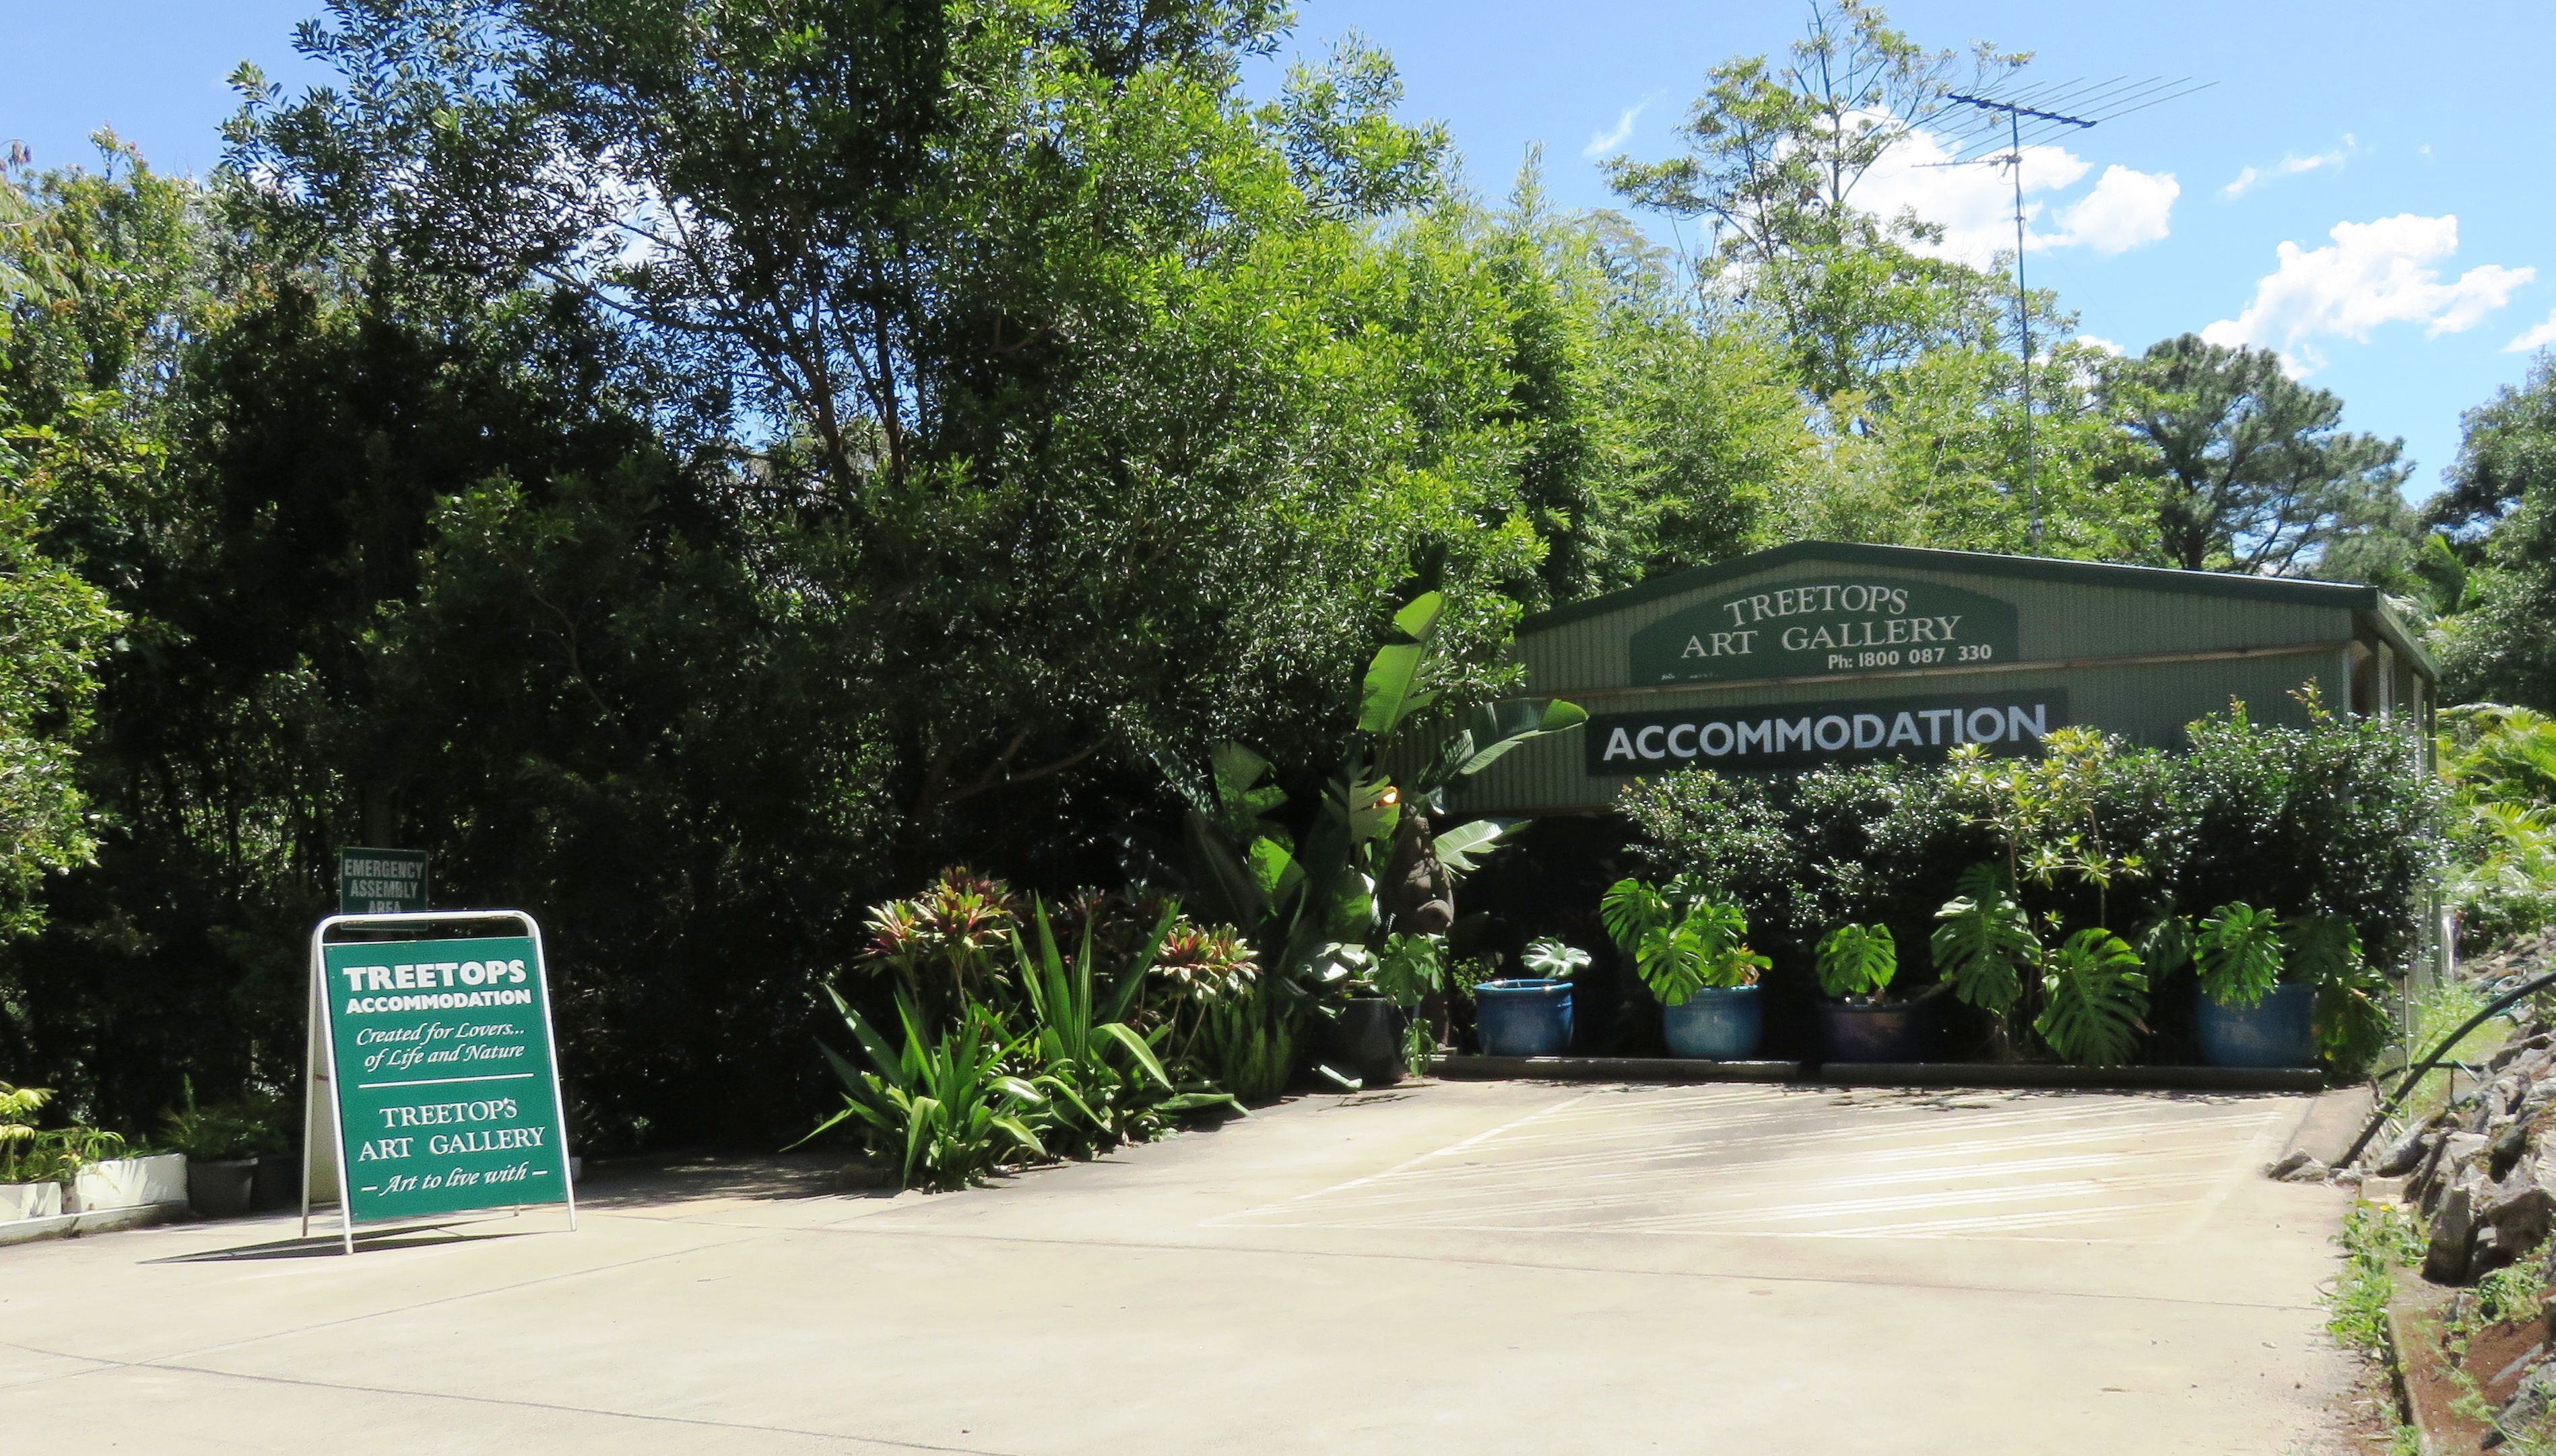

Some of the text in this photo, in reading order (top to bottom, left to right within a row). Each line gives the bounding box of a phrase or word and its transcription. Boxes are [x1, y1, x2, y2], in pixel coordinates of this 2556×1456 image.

[1724, 585, 1909, 628] TREETOPS
[1681, 616, 1963, 659] ART GALLERY
[1828, 644, 1992, 670] Ph: 1800 087 330
[1603, 704, 2046, 762] ACCOMMODATION
[344, 859, 423, 878] EMERGENCY
[350, 880, 418, 898] ASSEMBLY
[368, 900, 401, 913] AREA
[342, 959, 527, 991] TREETOPS
[345, 989, 531, 1014] ACCOMMODATION
[356, 1022, 525, 1046] Created for Lovers...
[364, 1044, 525, 1072] of Life and Nature
[358, 1126, 546, 1162] ART GALLERY
[378, 1174, 418, 1197] Art
[422, 1173, 443, 1189] to
[445, 1166, 478, 1187] live
[484, 1160, 529, 1183] with
